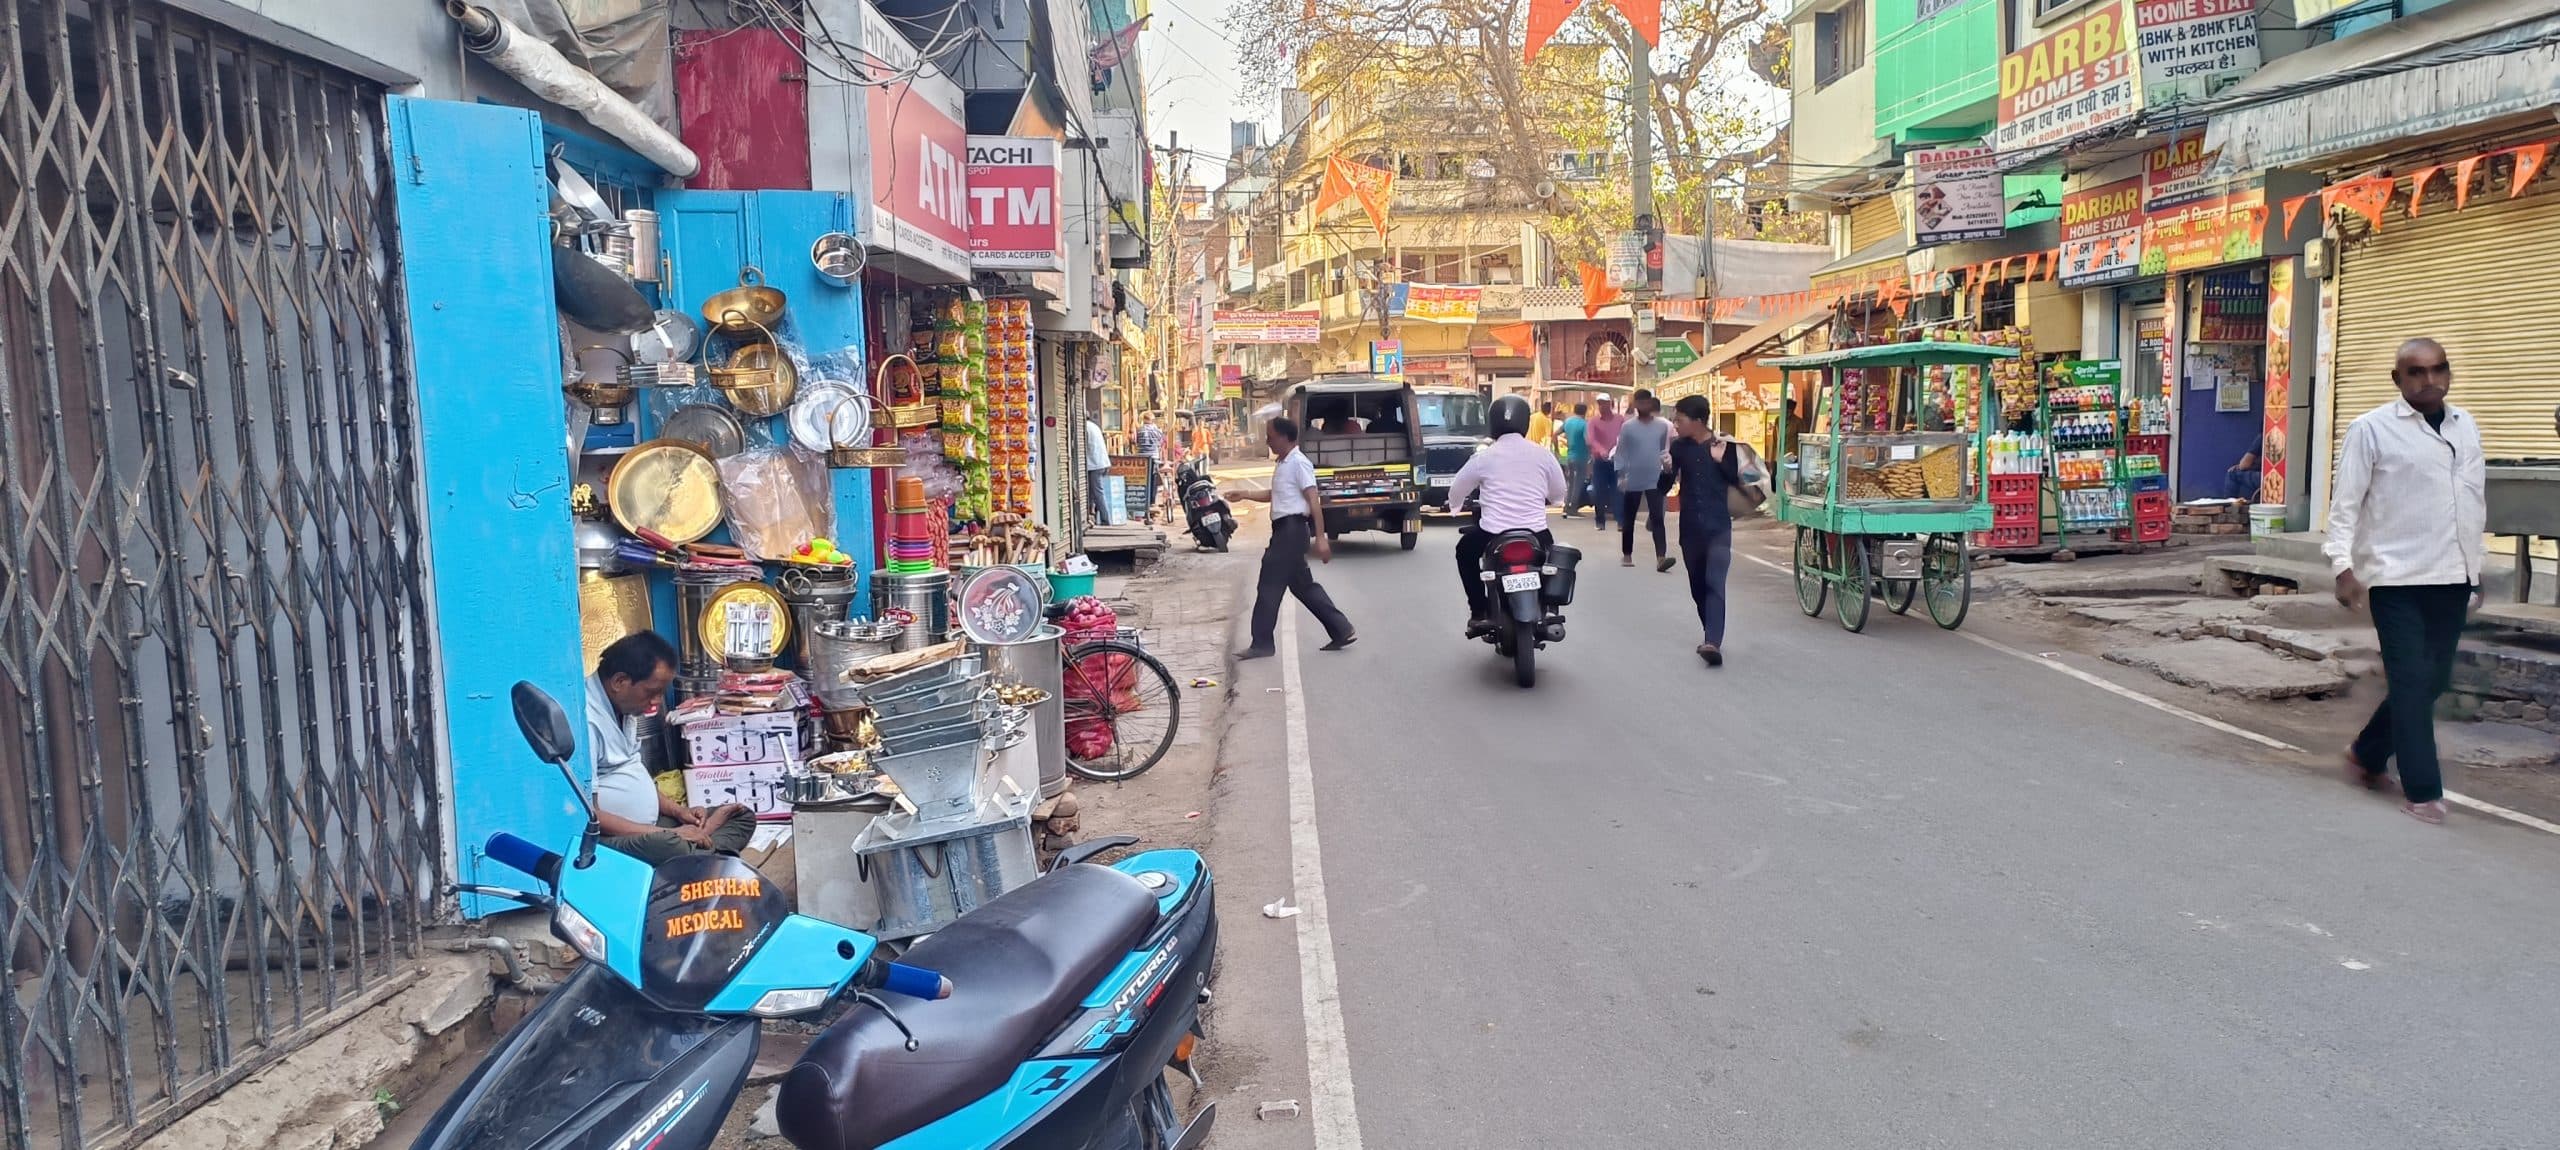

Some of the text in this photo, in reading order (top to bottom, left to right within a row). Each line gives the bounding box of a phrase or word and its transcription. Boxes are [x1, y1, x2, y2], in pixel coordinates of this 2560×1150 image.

[2138, 0, 2197, 25] HOME
[2177, 26, 2186, 41] &
[2190, 19, 2225, 39] 2BHK
[2148, 46, 2186, 63] WITH
[2191, 34, 2256, 57] KITCHEN
[2014, 68, 2086, 117] HOME
[2039, 127, 2064, 143] ROOM
[918, 133, 968, 232] ATM
[2065, 188, 2138, 226] DARBAR
[2069, 213, 2131, 240] HOME STAY
[979, 251, 1007, 260] CARDS
[1008, 251, 1051, 260] ACCEPTED
[680, 878, 761, 902] SHEKHAR
[666, 909, 743, 938] MEDICAL
[1114, 949, 1168, 1013] NTORQ
